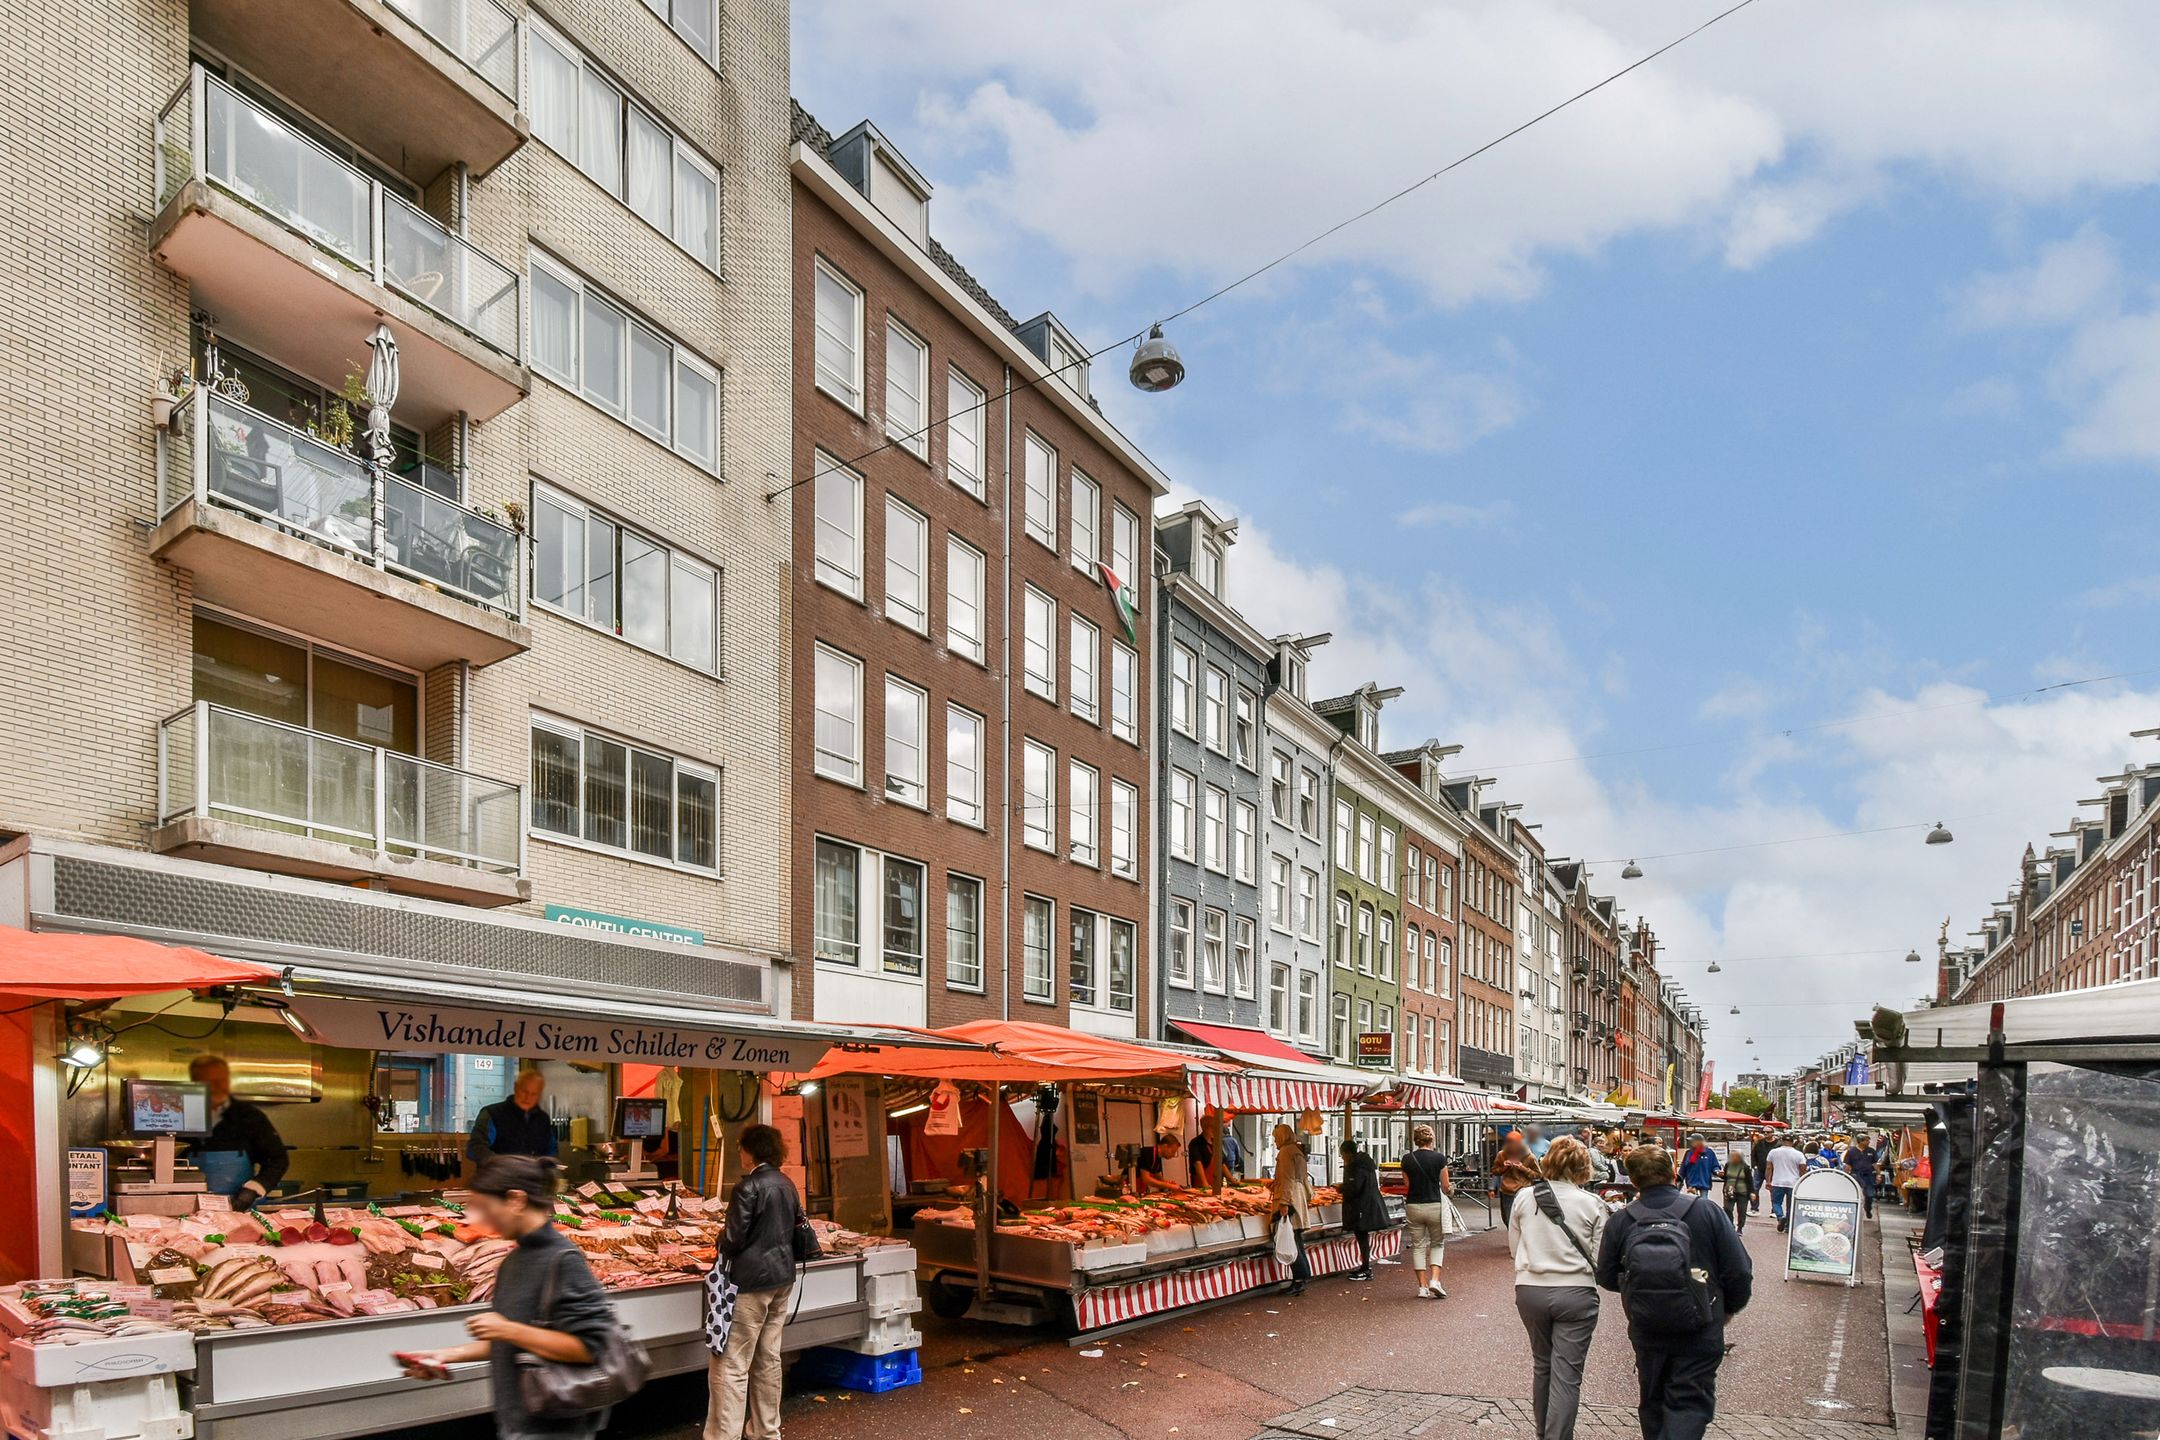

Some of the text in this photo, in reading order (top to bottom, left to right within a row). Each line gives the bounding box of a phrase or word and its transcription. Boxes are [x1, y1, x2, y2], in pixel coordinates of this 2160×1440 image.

[377, 1010, 790, 1064] Vishandel Siem Schilder & Zonen
[1359, 1036, 1383, 1045] GOTU
[476, 1059, 491, 1069] 149
[1798, 1203, 1853, 1214] POKE BOWL
[1802, 1210, 1848, 1220] FORMULA
